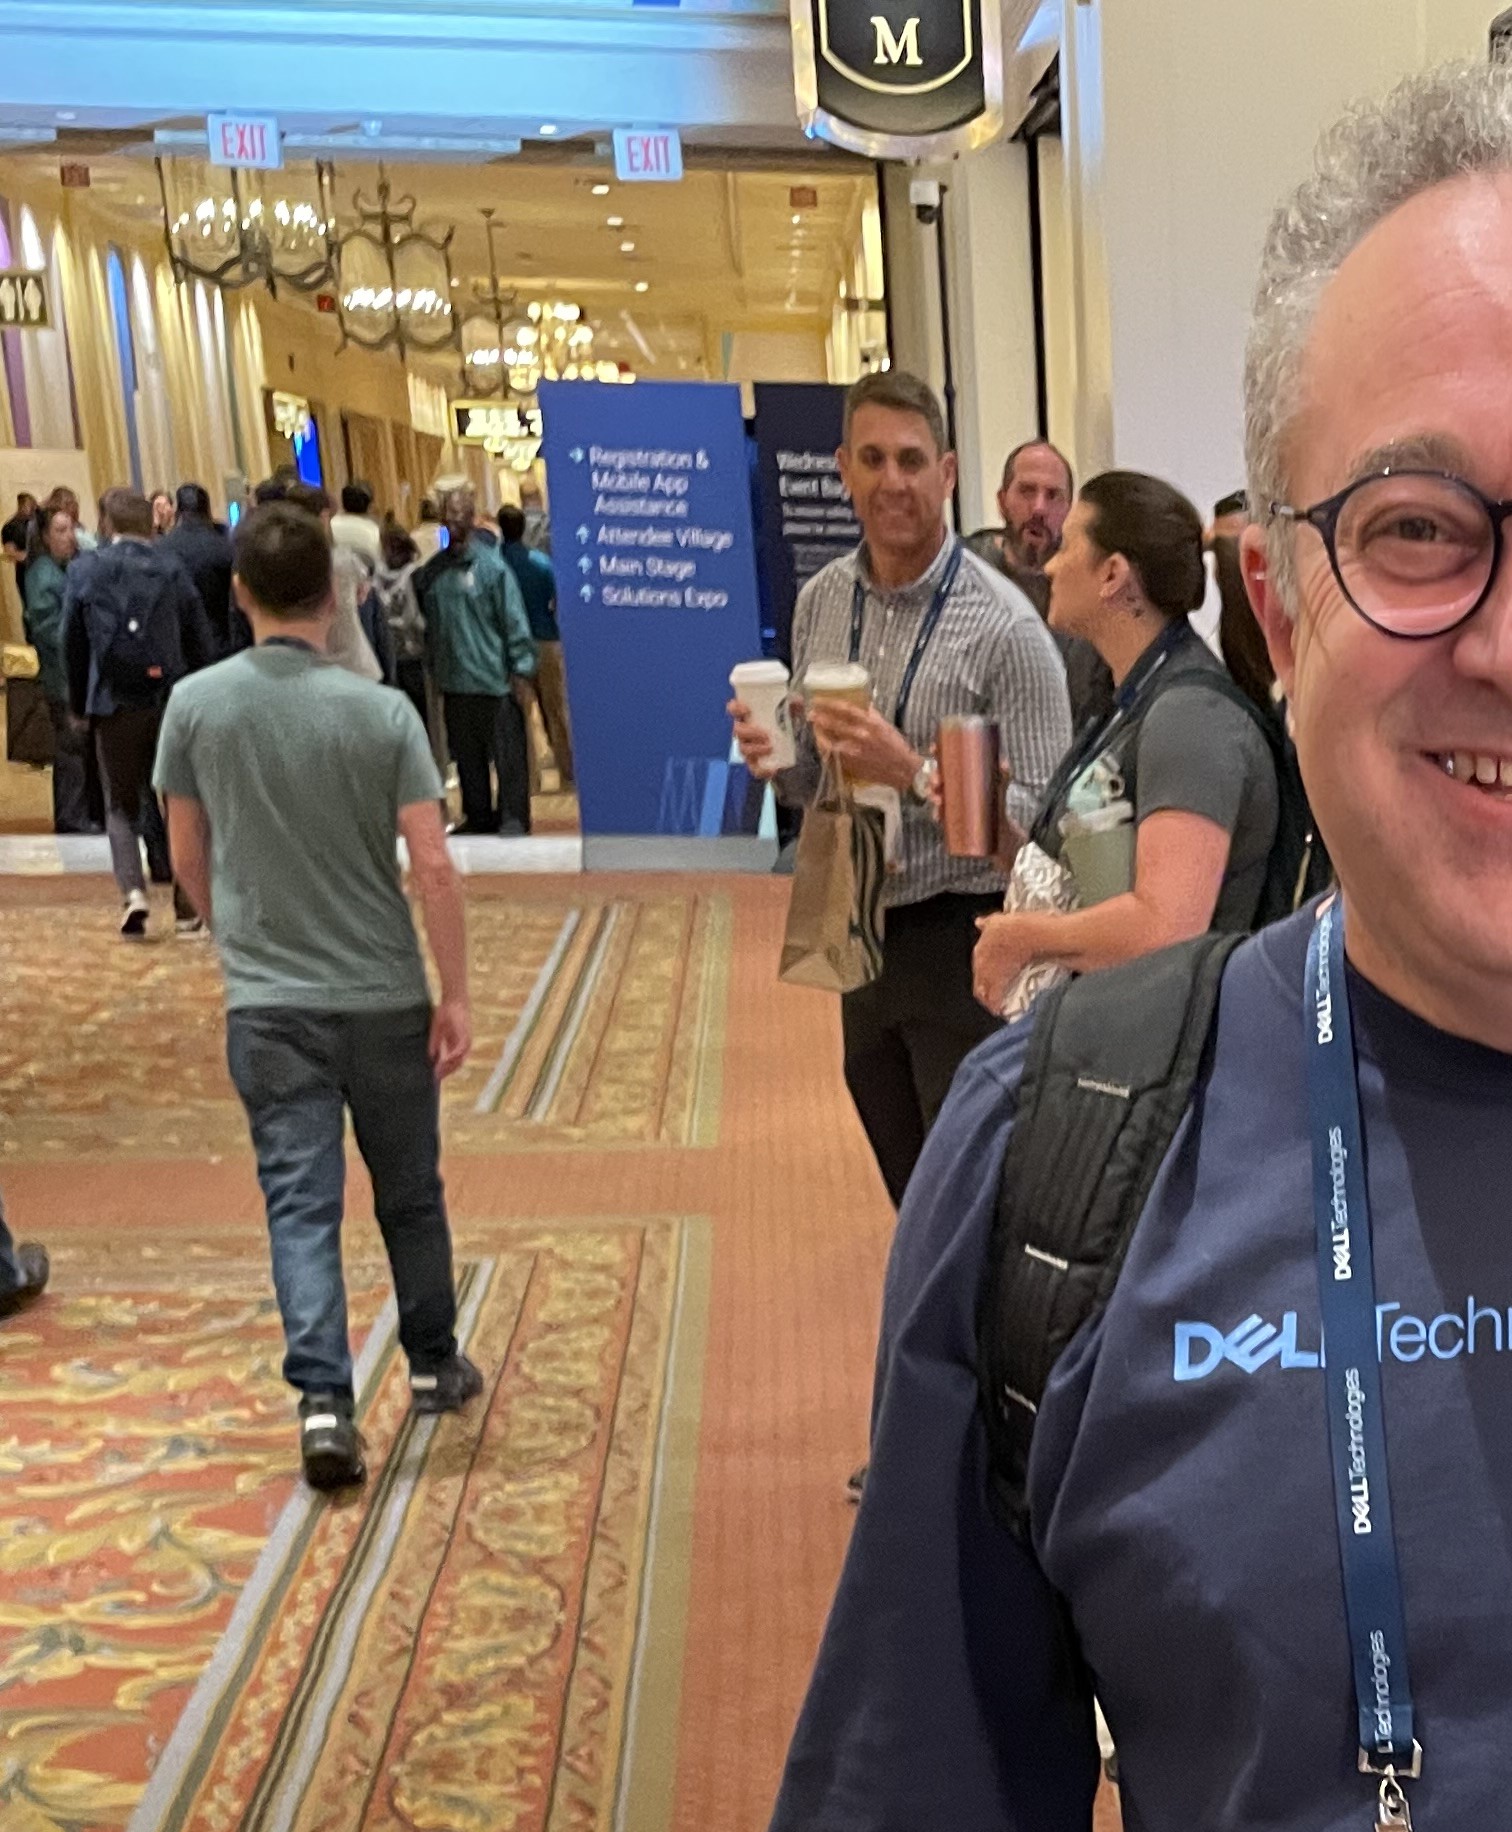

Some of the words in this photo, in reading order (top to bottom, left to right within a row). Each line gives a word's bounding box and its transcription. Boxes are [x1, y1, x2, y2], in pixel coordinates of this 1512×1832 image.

[870, 16, 923, 65] M
[221, 122, 266, 161] EXIT
[627, 135, 670, 174] EXIT
[589, 446, 693, 471] Registration
[592, 470, 651, 492] Mobile
[653, 473, 688, 496] App
[594, 494, 689, 518] Assistance
[597, 524, 673, 547] Attendee
[675, 526, 735, 554] Village
[600, 555, 643, 577] Main
[646, 556, 697, 582] Stage
[602, 585, 683, 607] Solutions
[685, 586, 729, 612] Expo
[1332, 1227, 1352, 1281] DELL
[1173, 1310, 1325, 1382] DEL
[1349, 1476, 1371, 1535] DELL
